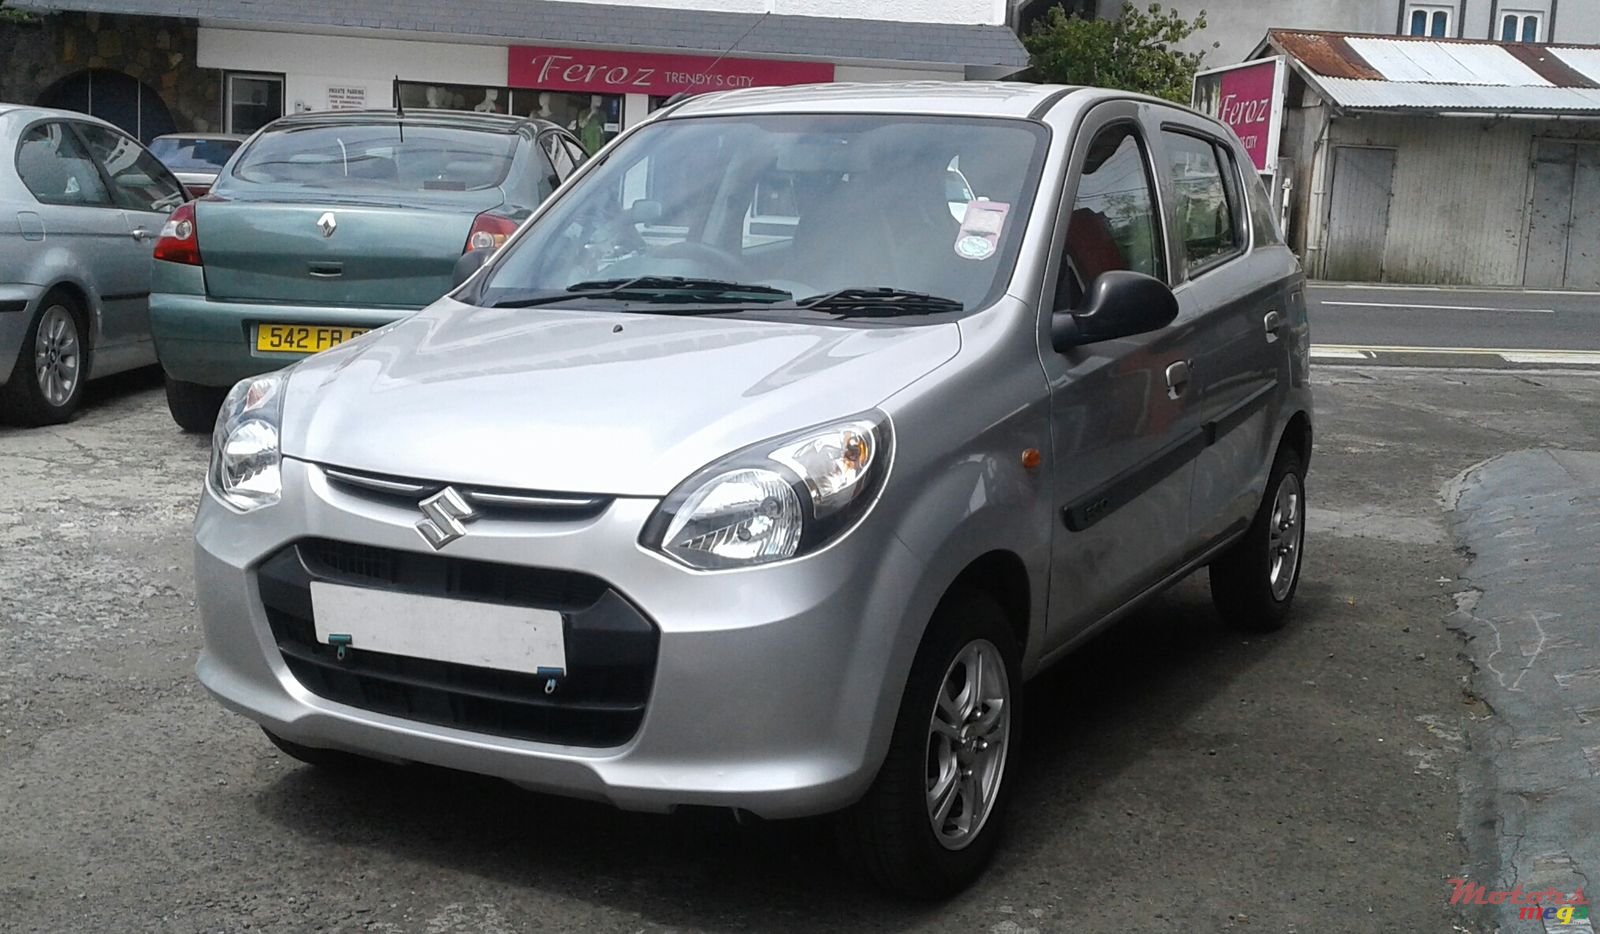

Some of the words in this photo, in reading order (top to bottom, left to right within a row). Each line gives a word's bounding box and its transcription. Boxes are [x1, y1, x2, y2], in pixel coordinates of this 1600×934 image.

[531, 55, 655, 86] Feroz
[664, 71, 723, 86] TRENDY'S
[726, 75, 754, 87] CITY
[1220, 94, 1269, 125] Feroz
[270, 327, 309, 349] 542
